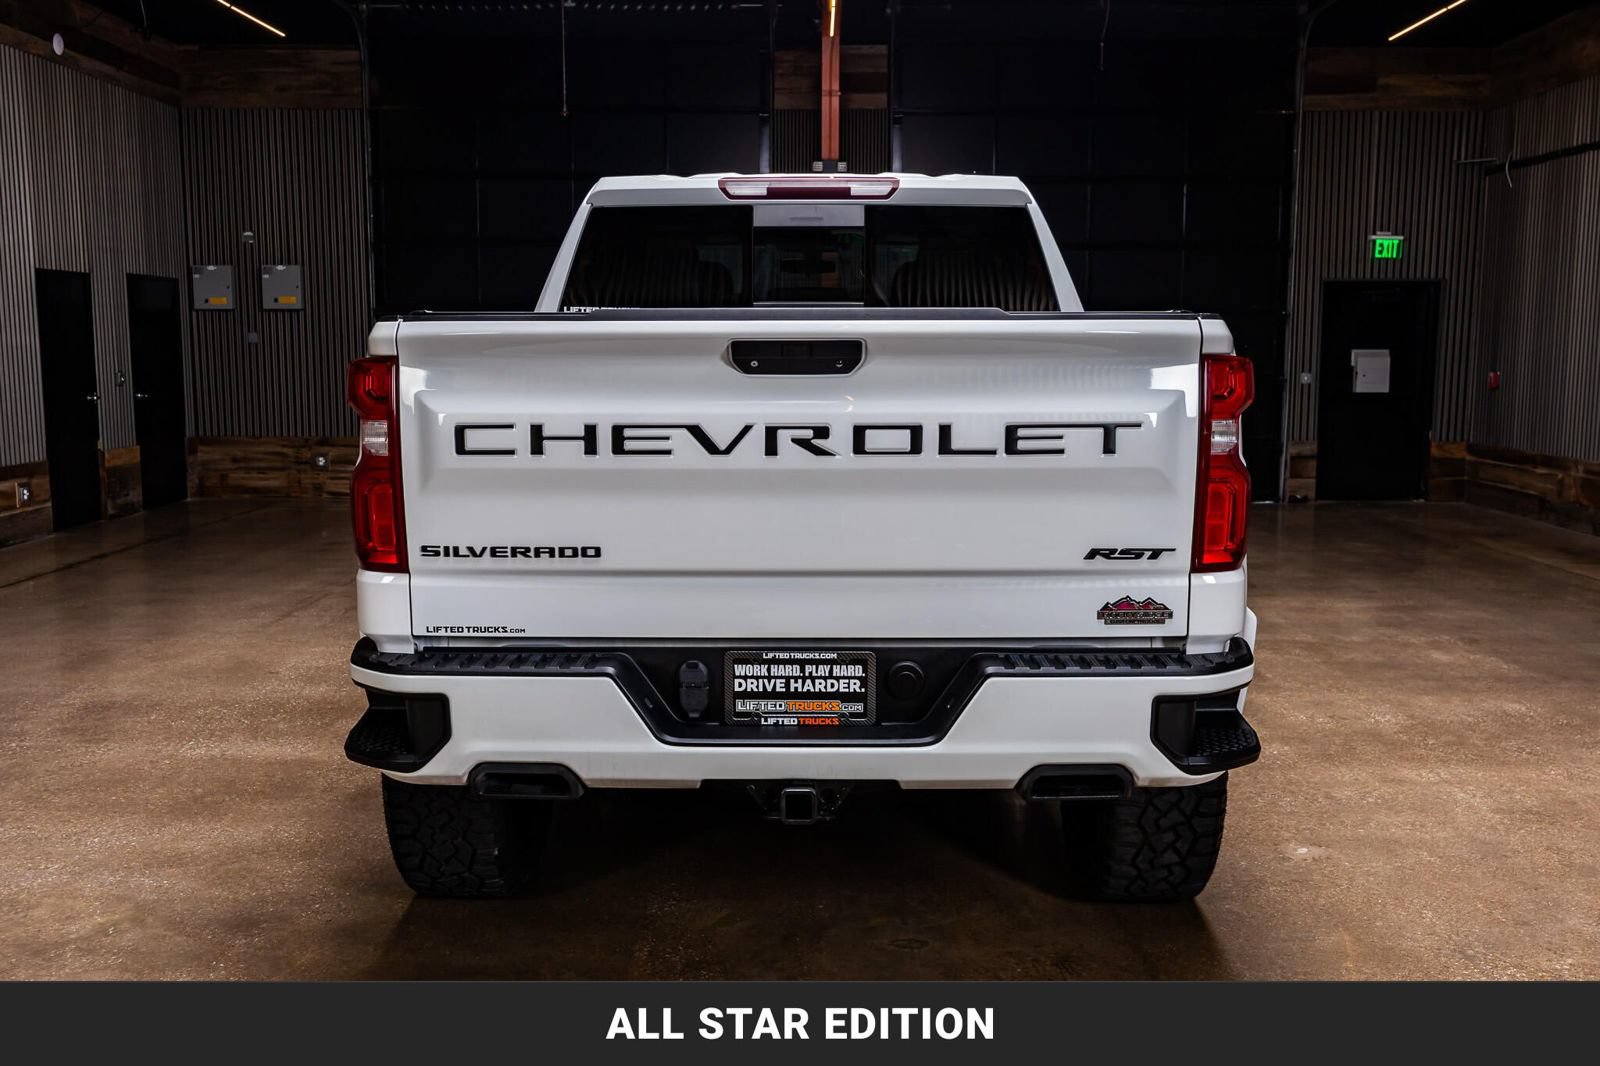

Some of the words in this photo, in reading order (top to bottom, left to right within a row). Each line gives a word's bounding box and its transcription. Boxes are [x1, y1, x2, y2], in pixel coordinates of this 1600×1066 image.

[1375, 238, 1400, 258] EXIT
[454, 422, 1142, 457] CHEVROLET
[420, 545, 602, 559] SILVERADO
[1083, 548, 1177, 560] RST
[734, 664, 768, 677] WORK
[770, 664, 803, 677] HARD.
[805, 664, 831, 677] PLAY
[832, 664, 866, 677] HARD.
[734, 678, 786, 692] DRIVE
[790, 678, 866, 693] HARDER.
[761, 717, 798, 725] LIFTED
[799, 717, 840, 725] TRUCKS
